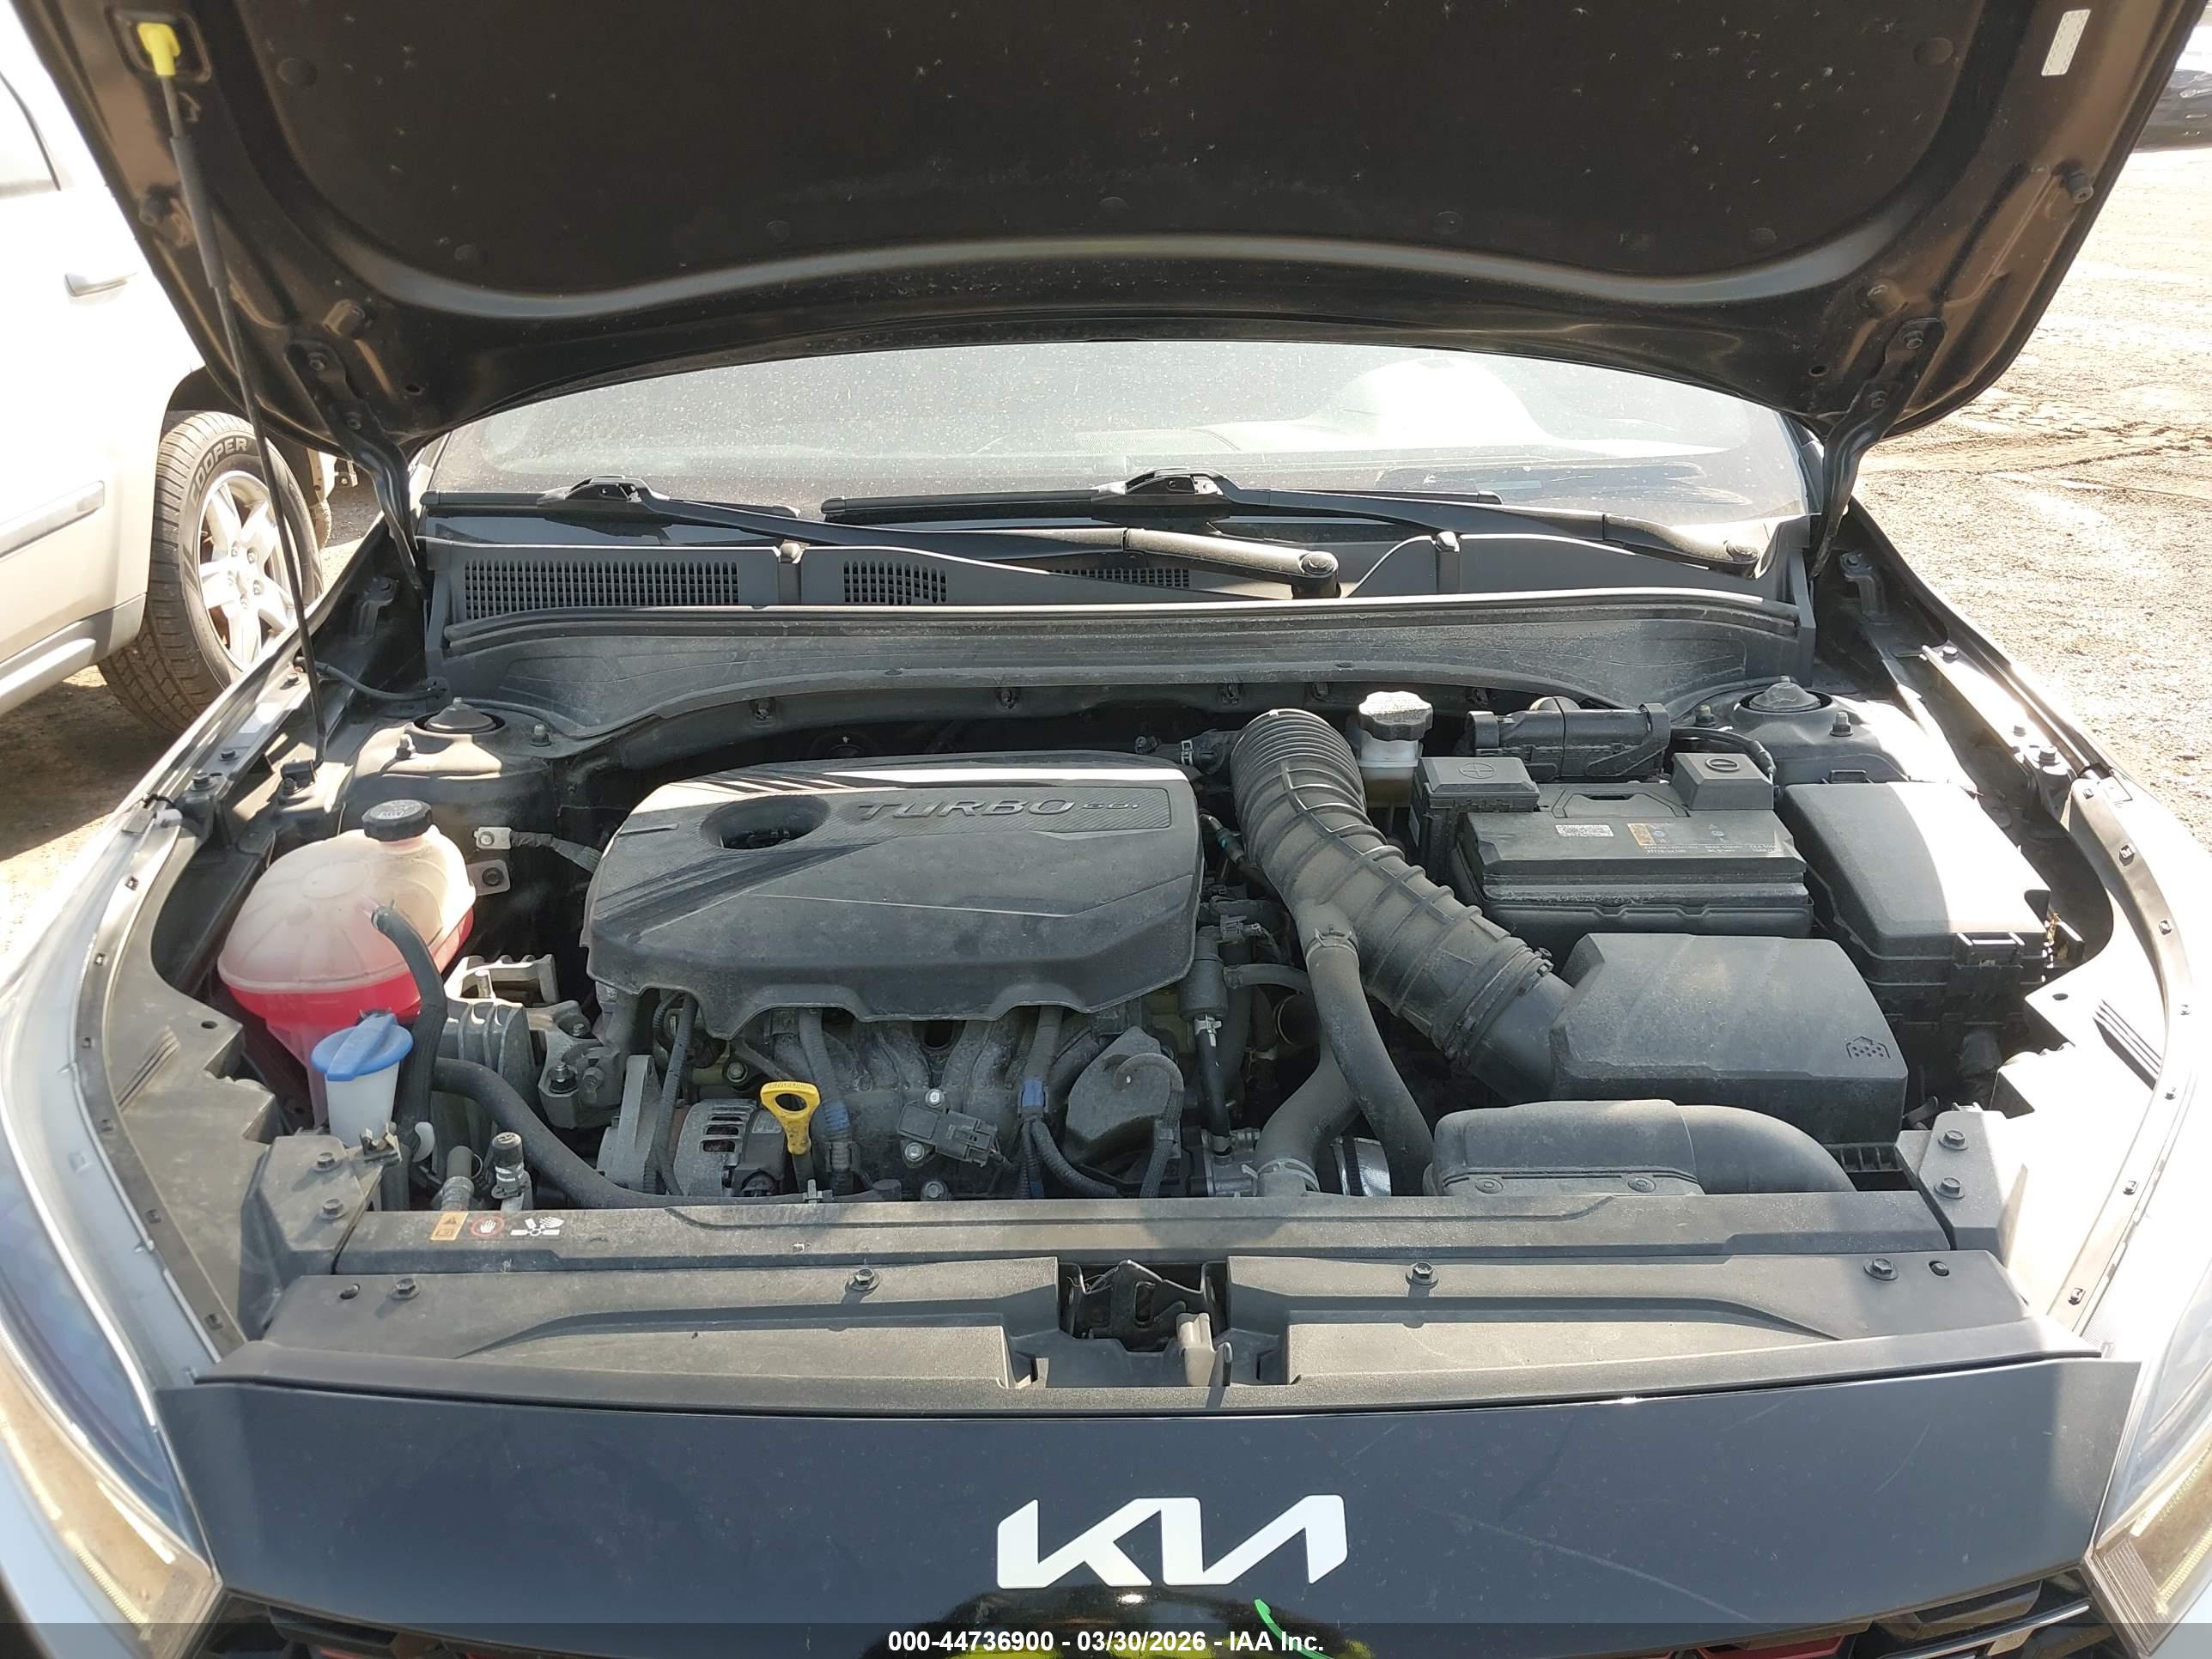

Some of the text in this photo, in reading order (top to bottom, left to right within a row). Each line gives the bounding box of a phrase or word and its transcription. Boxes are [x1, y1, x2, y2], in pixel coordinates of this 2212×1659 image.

[190, 437, 247, 508] COOPER
[858, 799, 1075, 821] TURBO
[997, 1494, 1348, 1589] KIA
